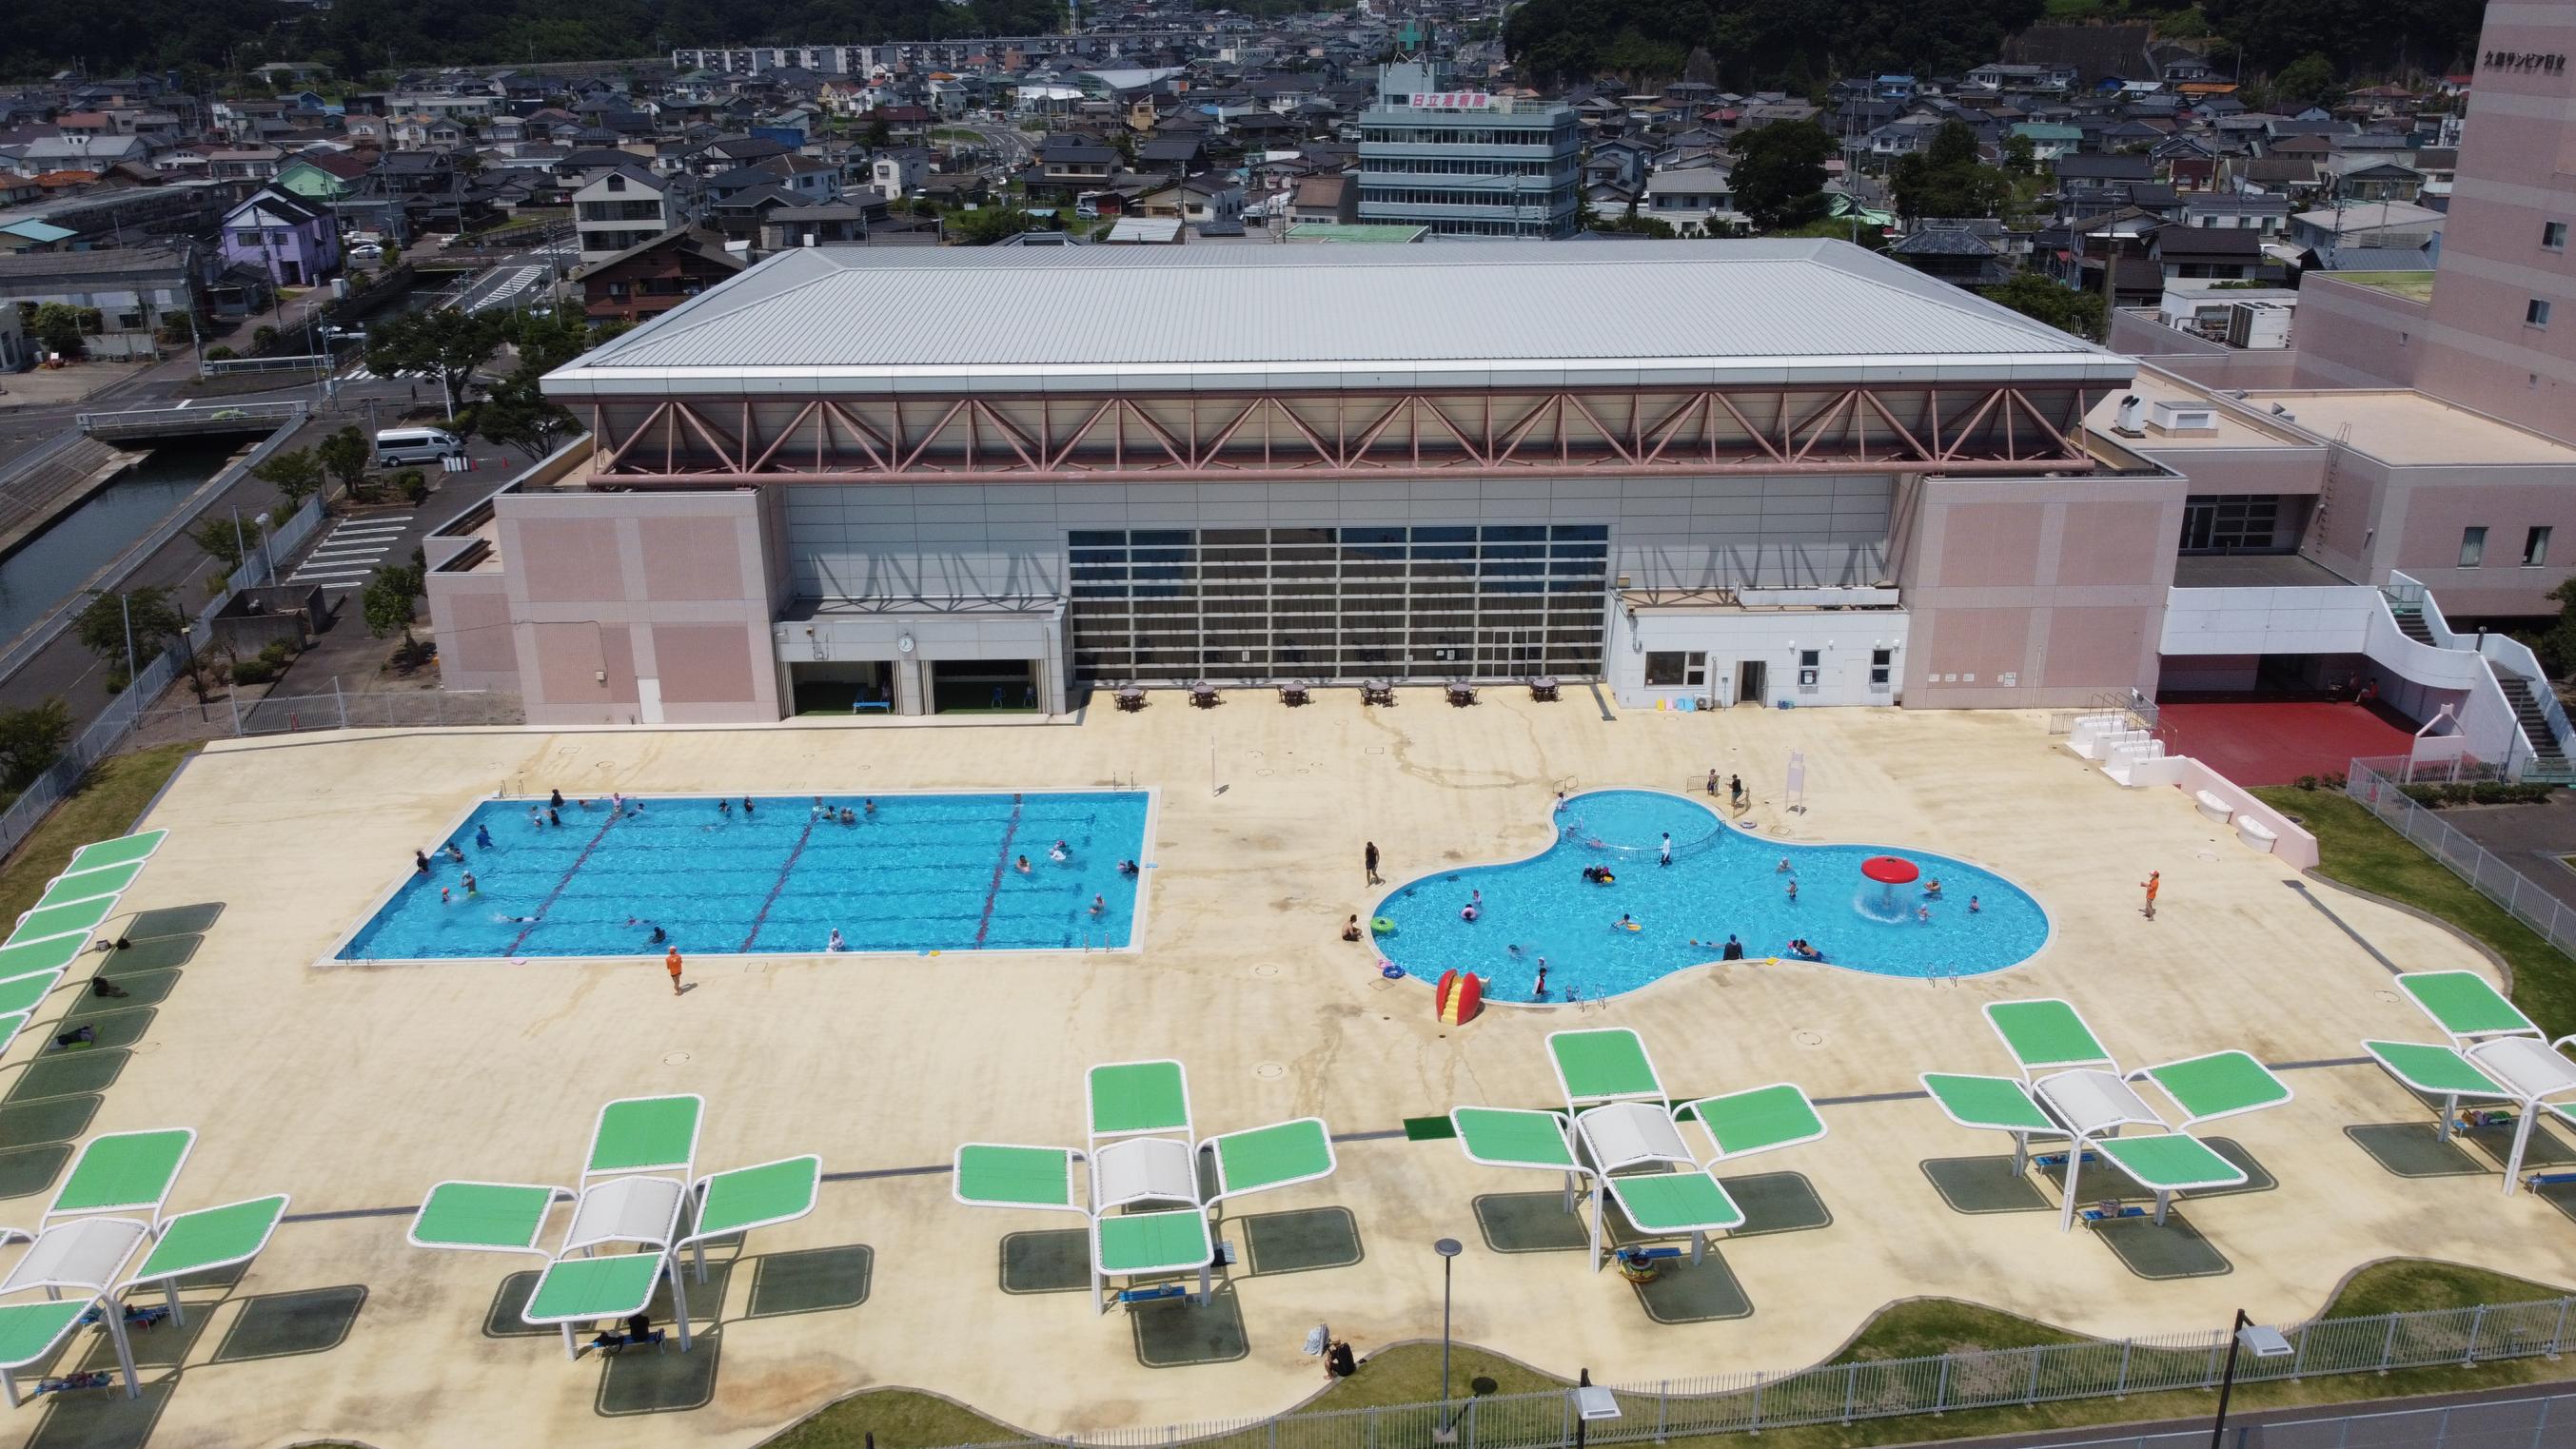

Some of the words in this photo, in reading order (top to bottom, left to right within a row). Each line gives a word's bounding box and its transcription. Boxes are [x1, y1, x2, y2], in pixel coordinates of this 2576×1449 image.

[1412, 93, 1486, 108] 日立港病院
